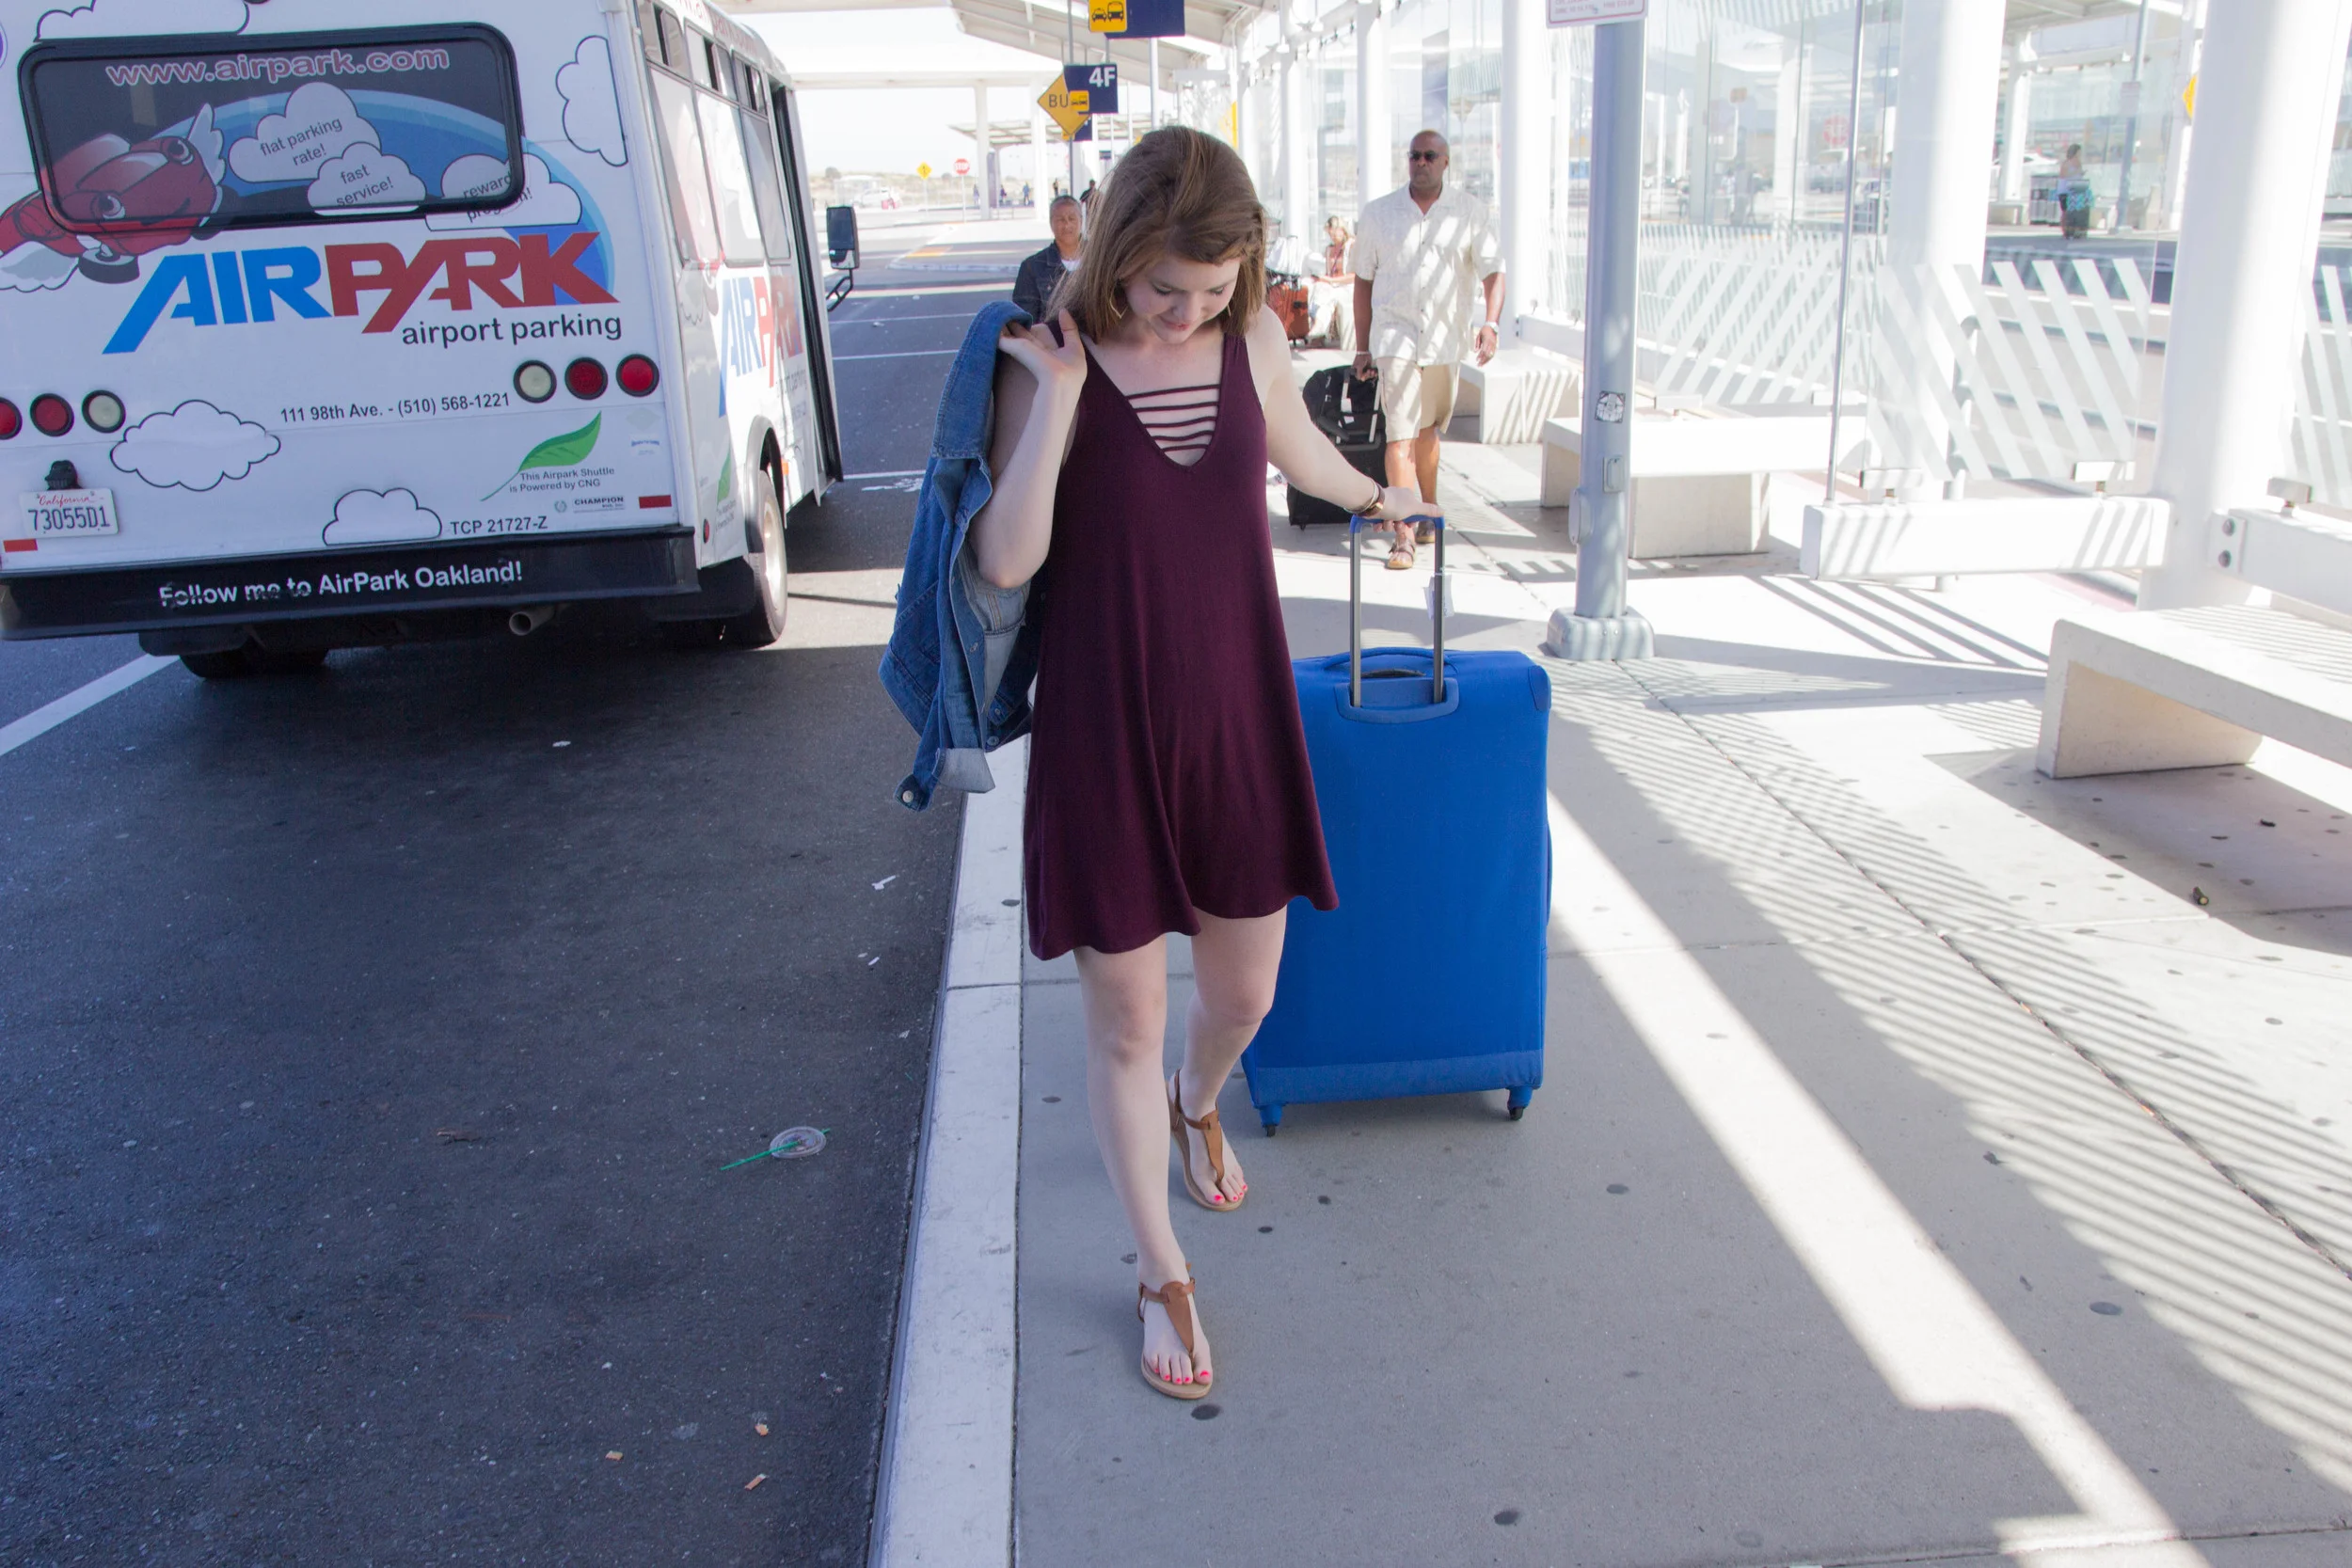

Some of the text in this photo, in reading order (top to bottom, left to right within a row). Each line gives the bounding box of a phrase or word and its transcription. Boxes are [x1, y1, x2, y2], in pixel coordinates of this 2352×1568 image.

[105, 48, 450, 86] www.airpark.com
[1089, 67, 1116, 87] 4F
[1048, 94, 1069, 108] BU
[260, 118, 342, 157] flat parking
[293, 144, 327, 167] rate!
[341, 164, 371, 185] fast
[336, 177, 394, 207] service!
[103, 232, 621, 355] AIRPARK
[402, 313, 622, 348] airport parking
[280, 408, 304, 423] 111
[310, 404, 345, 420] 98th
[350, 403, 383, 418] Ave.
[398, 398, 437, 417] (510)
[441, 392, 510, 411] 568-1221
[509, 478, 600, 493] is Powered by CNG
[520, 467, 614, 482] This Airpark Shuttle
[39, 494, 89, 507] California
[574, 497, 624, 505] CHAMPION
[451, 515, 548, 534] TCP 21727-Z
[159, 561, 522, 607] Follow me to AirPark Oakland!
